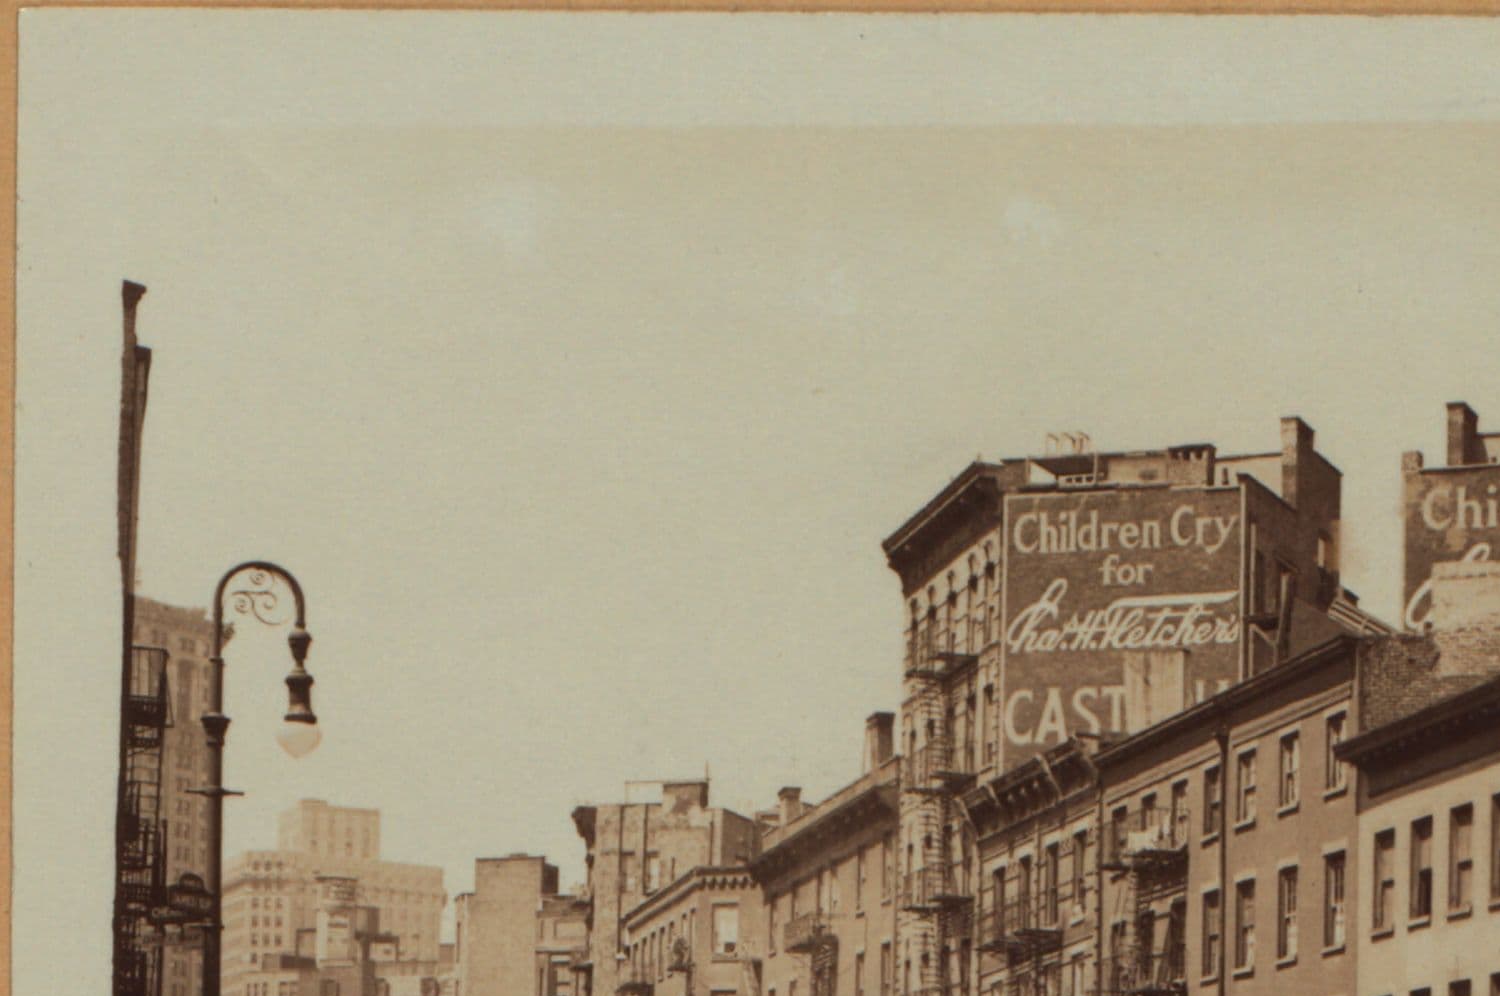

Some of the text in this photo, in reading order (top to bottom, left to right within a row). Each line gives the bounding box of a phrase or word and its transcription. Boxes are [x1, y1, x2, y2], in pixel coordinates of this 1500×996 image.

[1013, 505, 1237, 554] Children Cry
[1099, 557, 1154, 586] for
